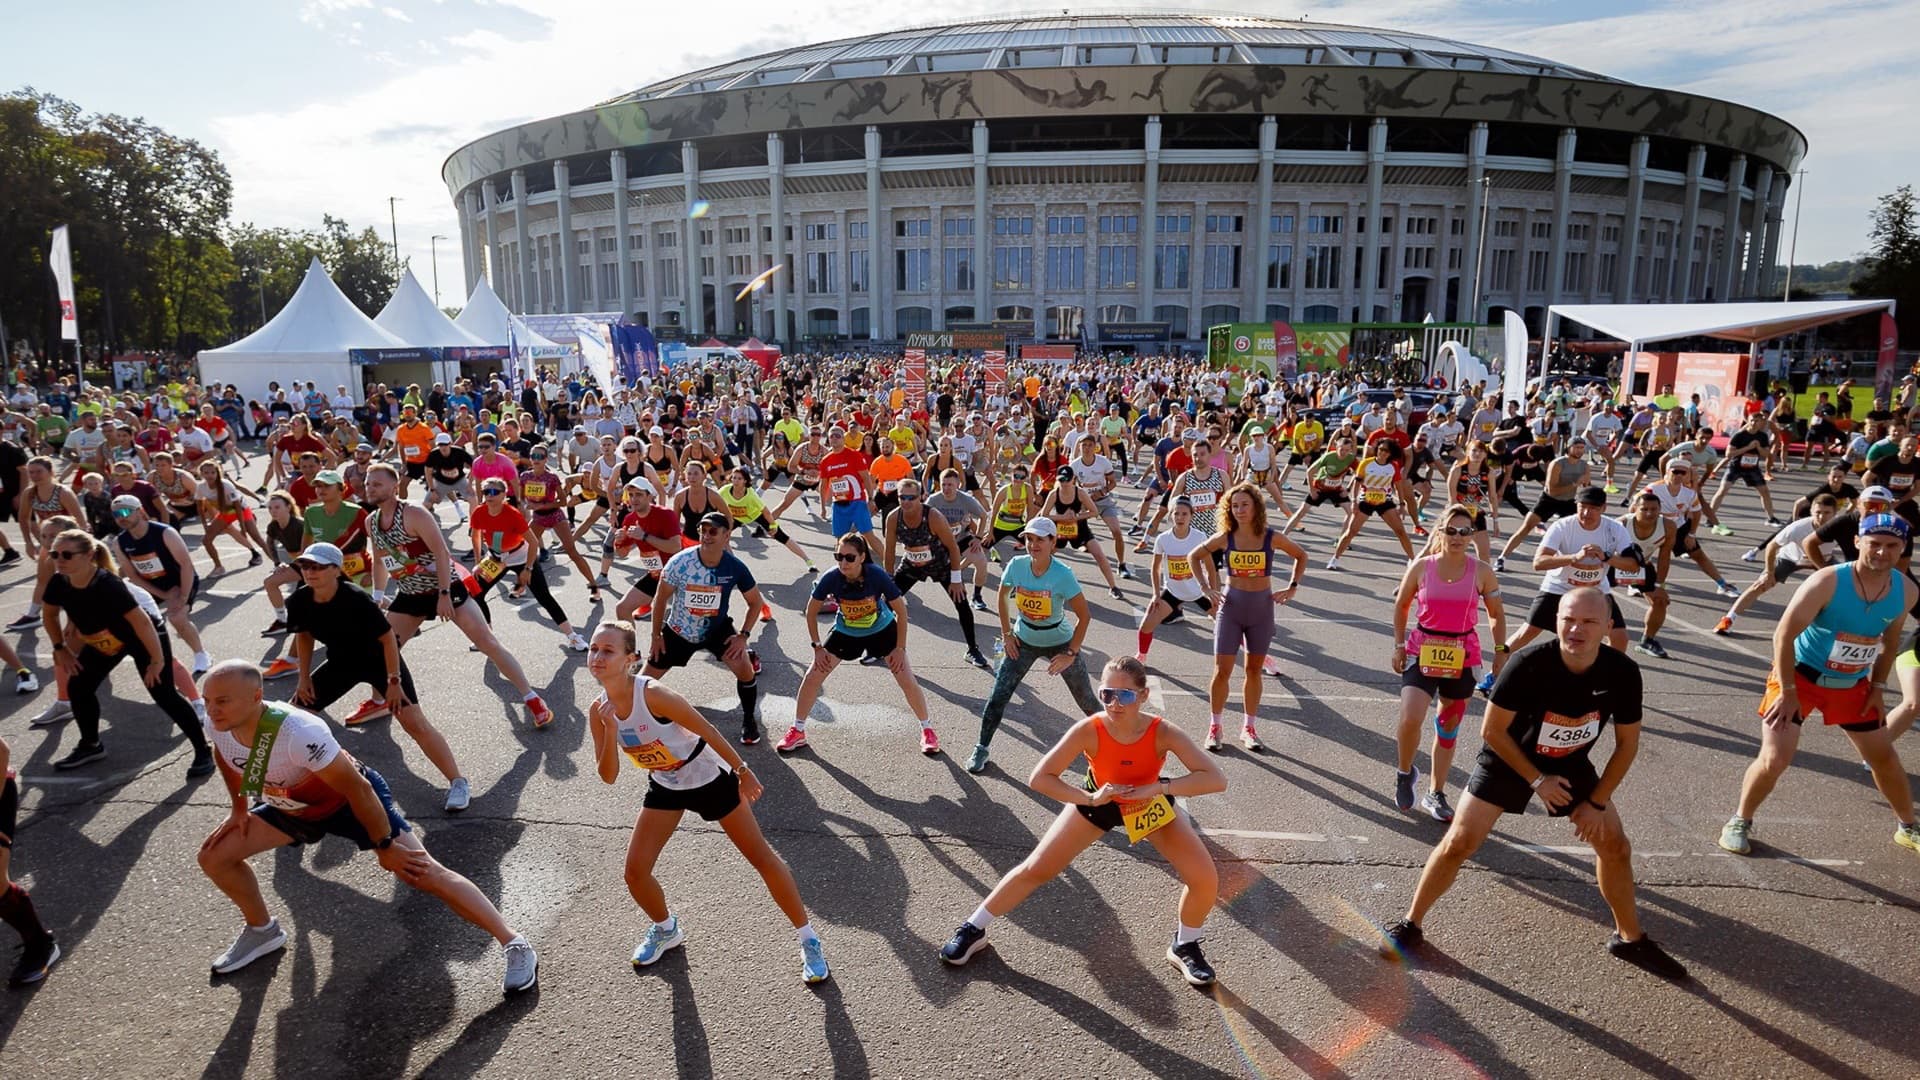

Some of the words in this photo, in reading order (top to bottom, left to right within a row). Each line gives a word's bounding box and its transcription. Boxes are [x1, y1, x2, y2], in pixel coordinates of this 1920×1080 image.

[1194, 495, 1212, 503] 7411
[1234, 555, 1260, 565] 6100
[1170, 562, 1189, 571] 1837
[1574, 570, 1599, 578] 4889
[690, 594, 716, 605] 2507
[1023, 599, 1042, 610] 402
[1431, 648, 1454, 662] 104
[1841, 645, 1876, 659] 7410
[1549, 726, 1591, 742] 4386
[248, 732, 273, 784] ЭСТАФЕТА
[1134, 802, 1166, 831] 4753
